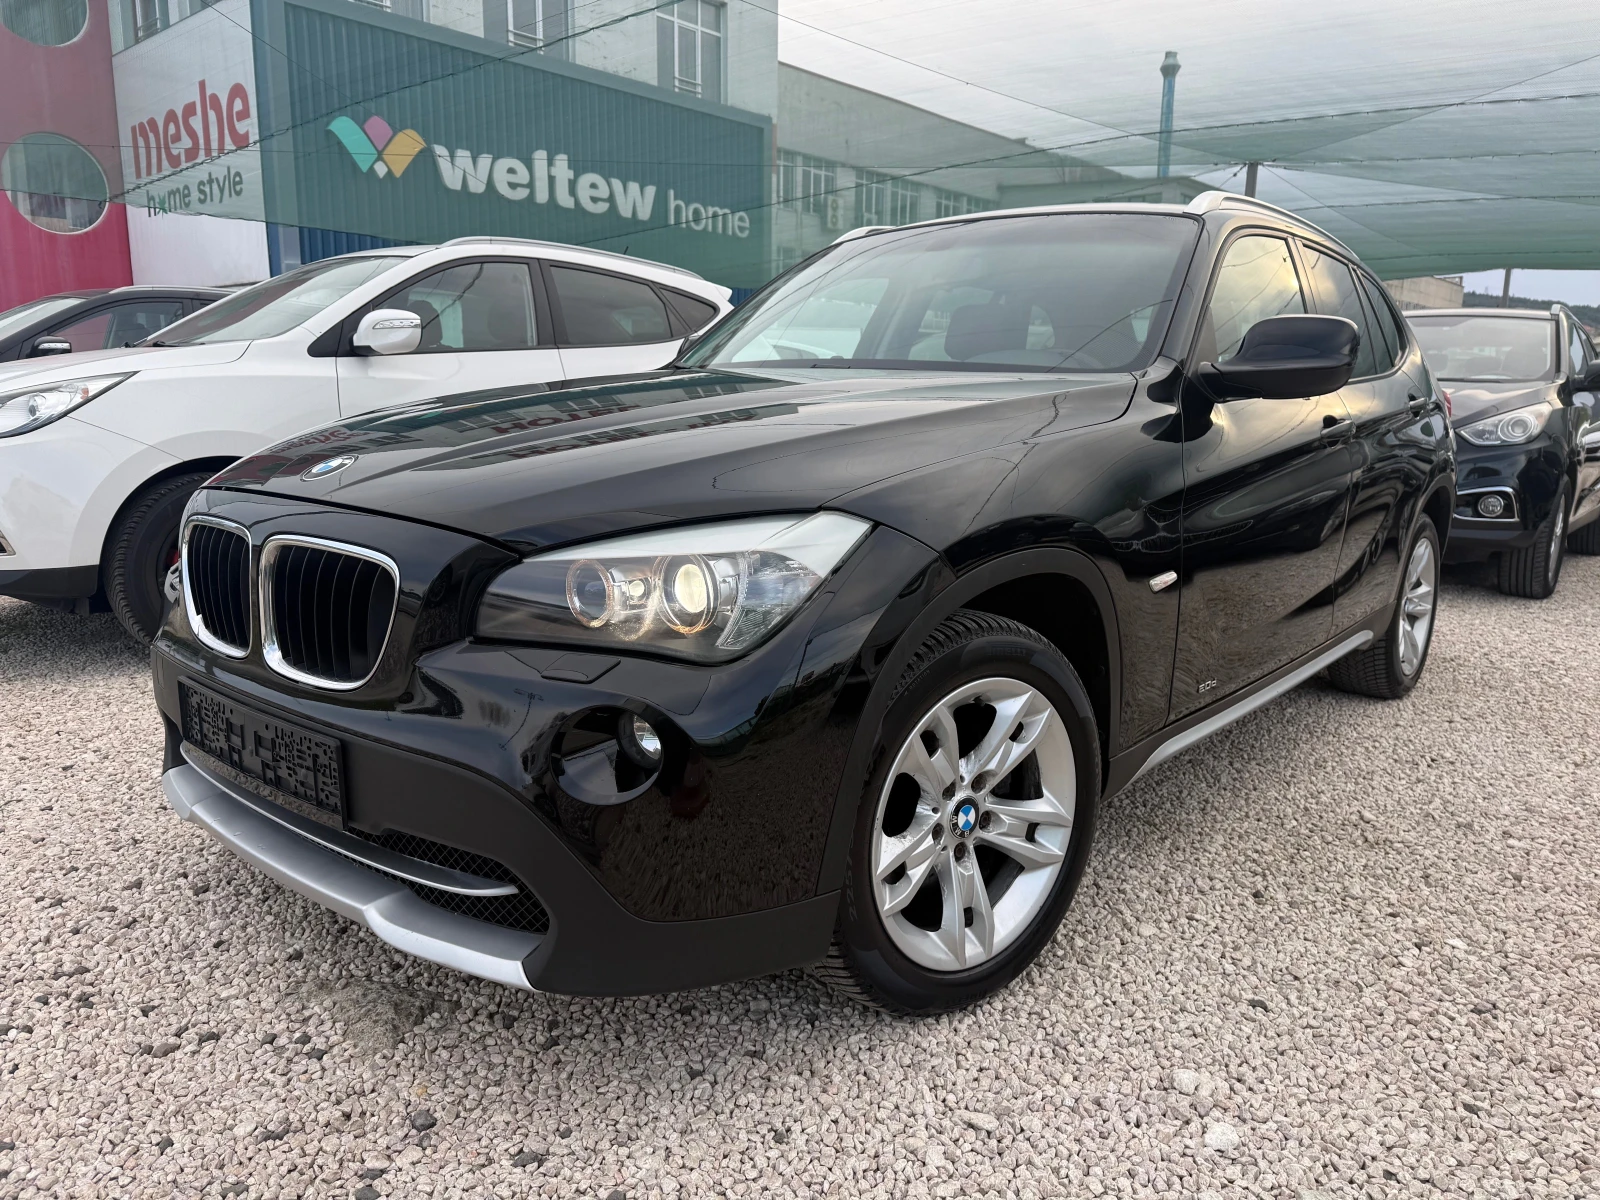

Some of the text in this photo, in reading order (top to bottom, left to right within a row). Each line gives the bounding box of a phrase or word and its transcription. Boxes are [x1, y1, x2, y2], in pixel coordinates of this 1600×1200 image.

[130, 78, 251, 180] meshe
[197, 165, 243, 204] style
[432, 143, 750, 238] weltew home
